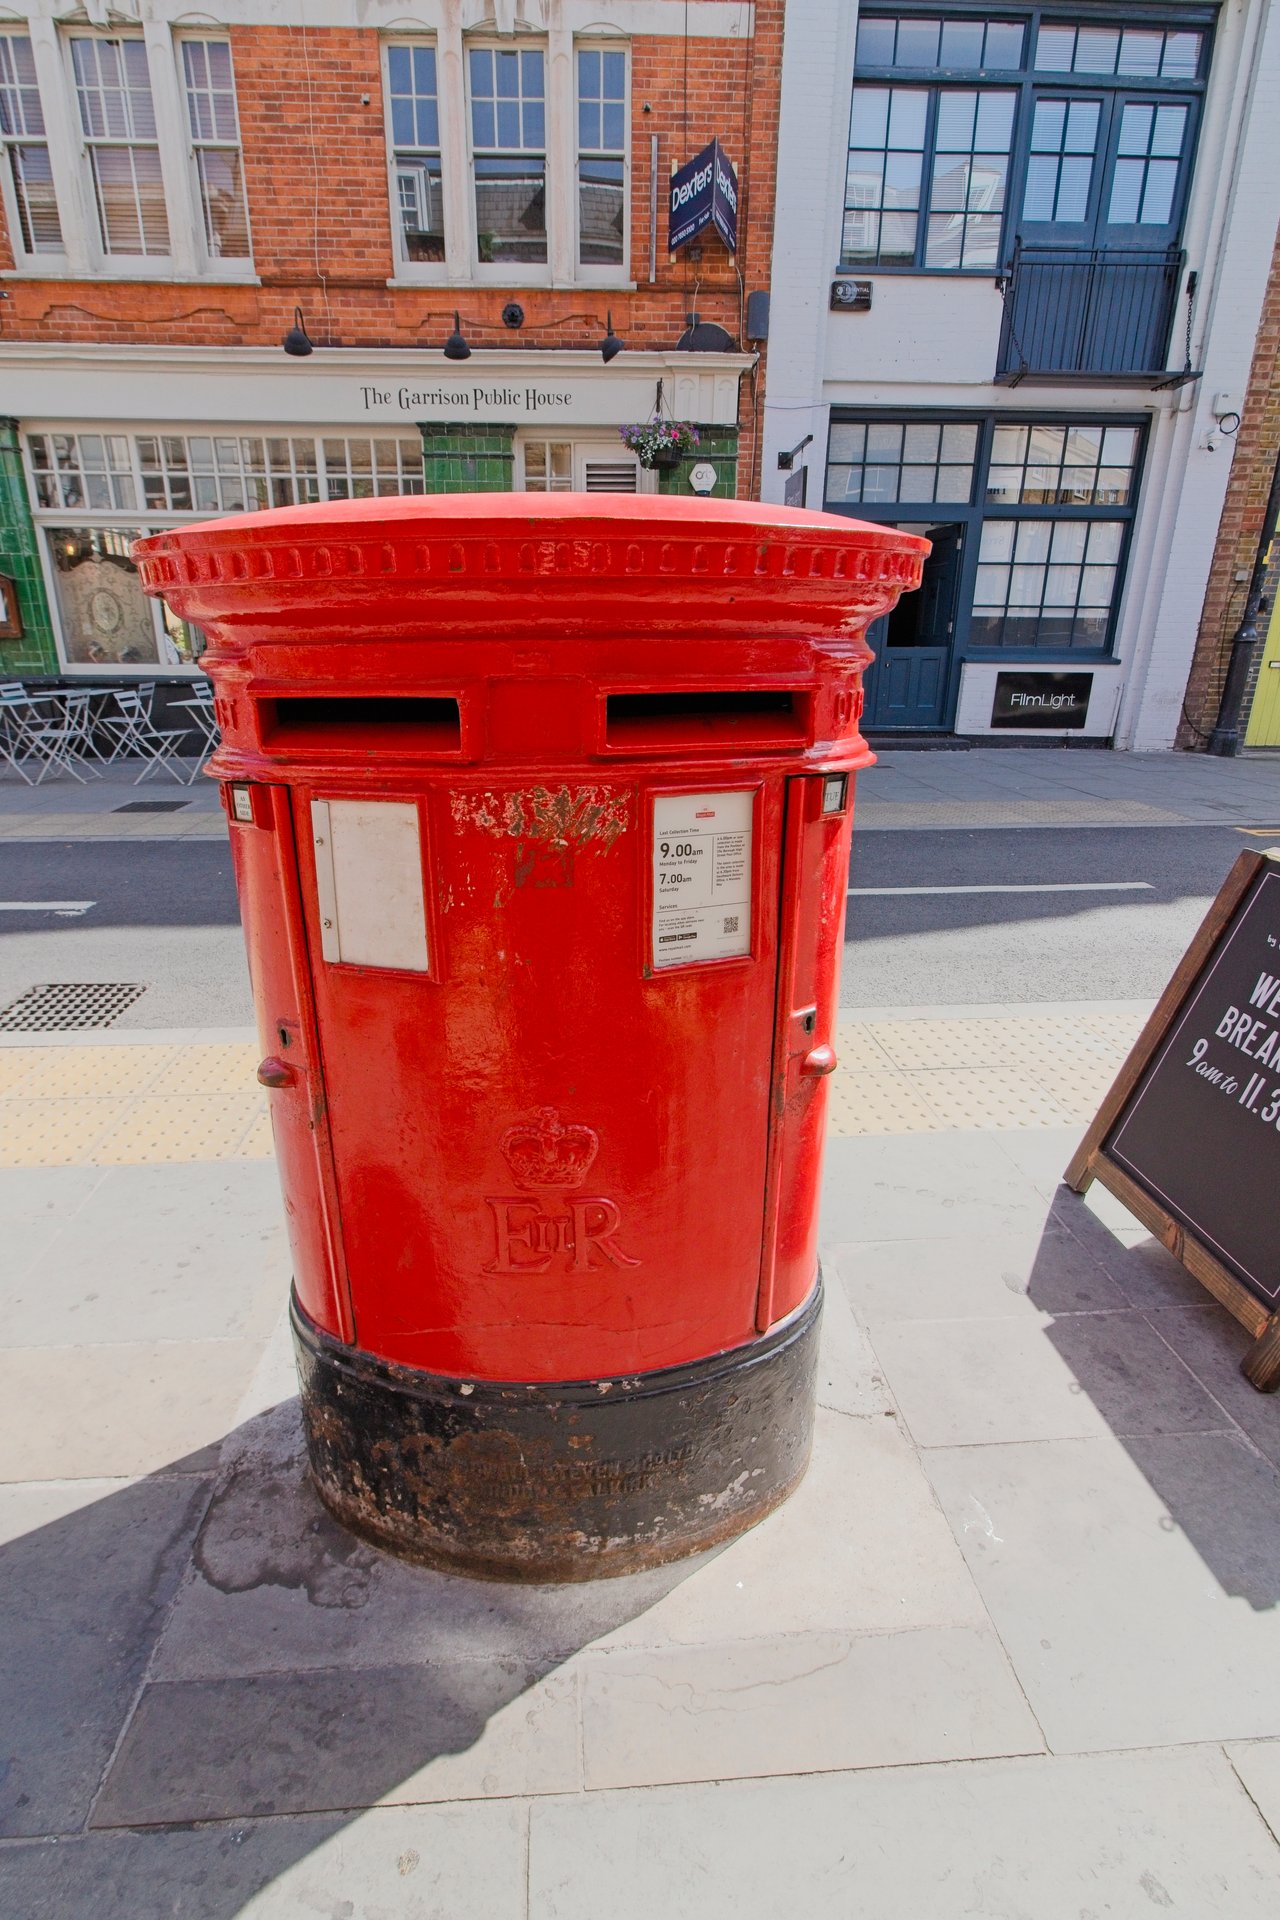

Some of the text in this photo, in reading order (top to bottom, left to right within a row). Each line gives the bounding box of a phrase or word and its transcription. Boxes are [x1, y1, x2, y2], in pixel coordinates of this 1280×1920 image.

[672, 162, 713, 212] Dexters
[360, 386, 573, 411] The Garrison Public House
[1010, 692, 1076, 710] FilmLight
[660, 842, 704, 859] 9.00am
[659, 873, 692, 885] 7.00am
[1267, 934, 1277, 947] by
